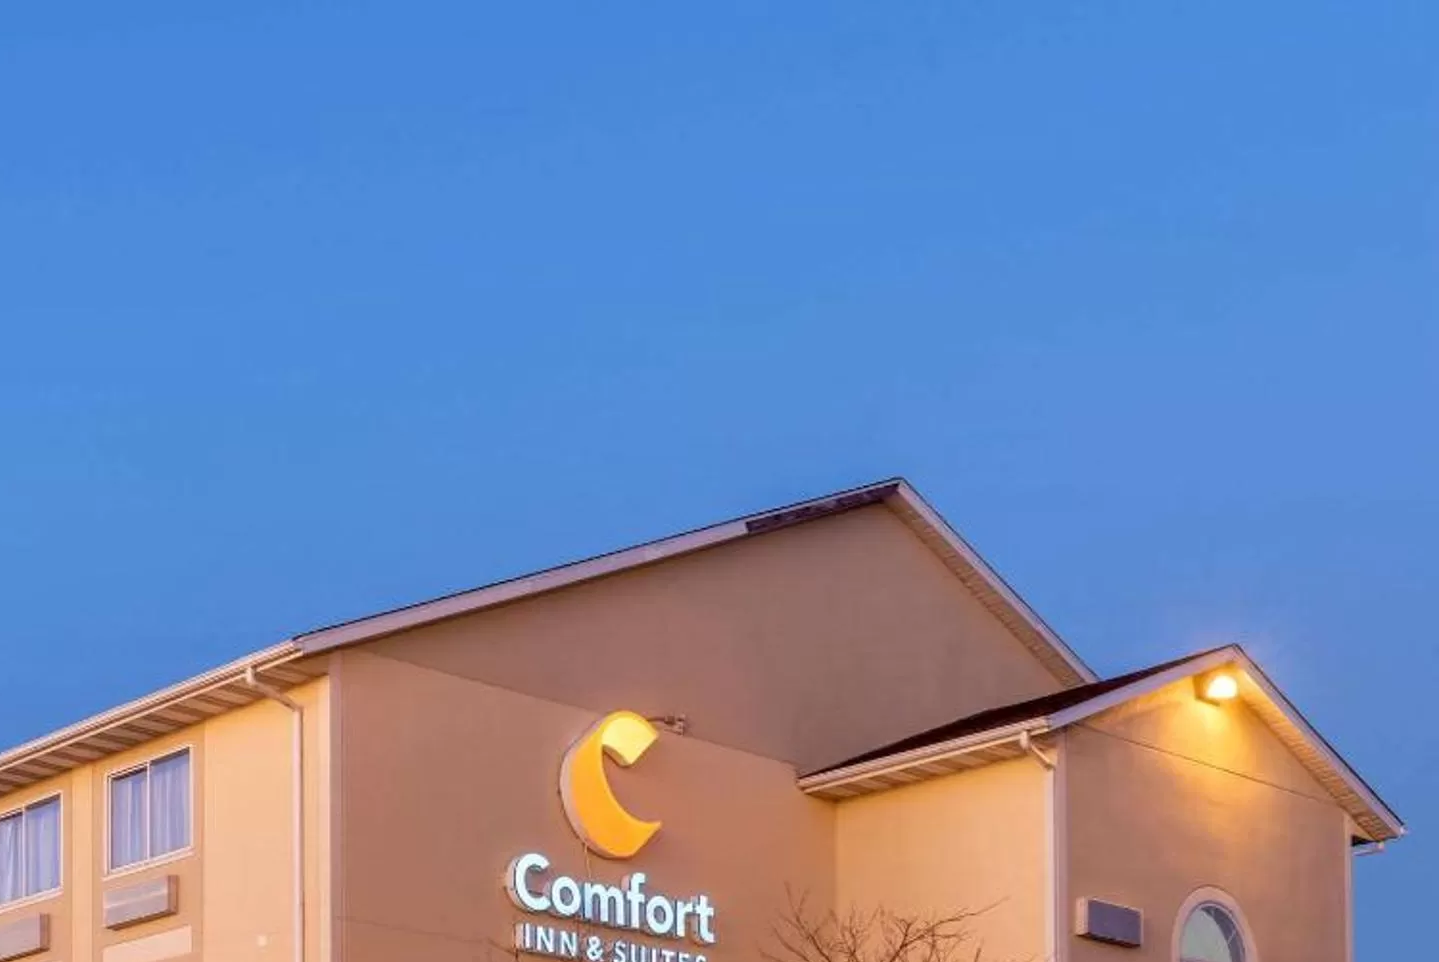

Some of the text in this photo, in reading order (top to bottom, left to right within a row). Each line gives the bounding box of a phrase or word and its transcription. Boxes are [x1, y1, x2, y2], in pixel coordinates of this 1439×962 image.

[506, 853, 715, 943] Comfort
[516, 923, 578, 957] INN
[586, 936, 604, 962] &
